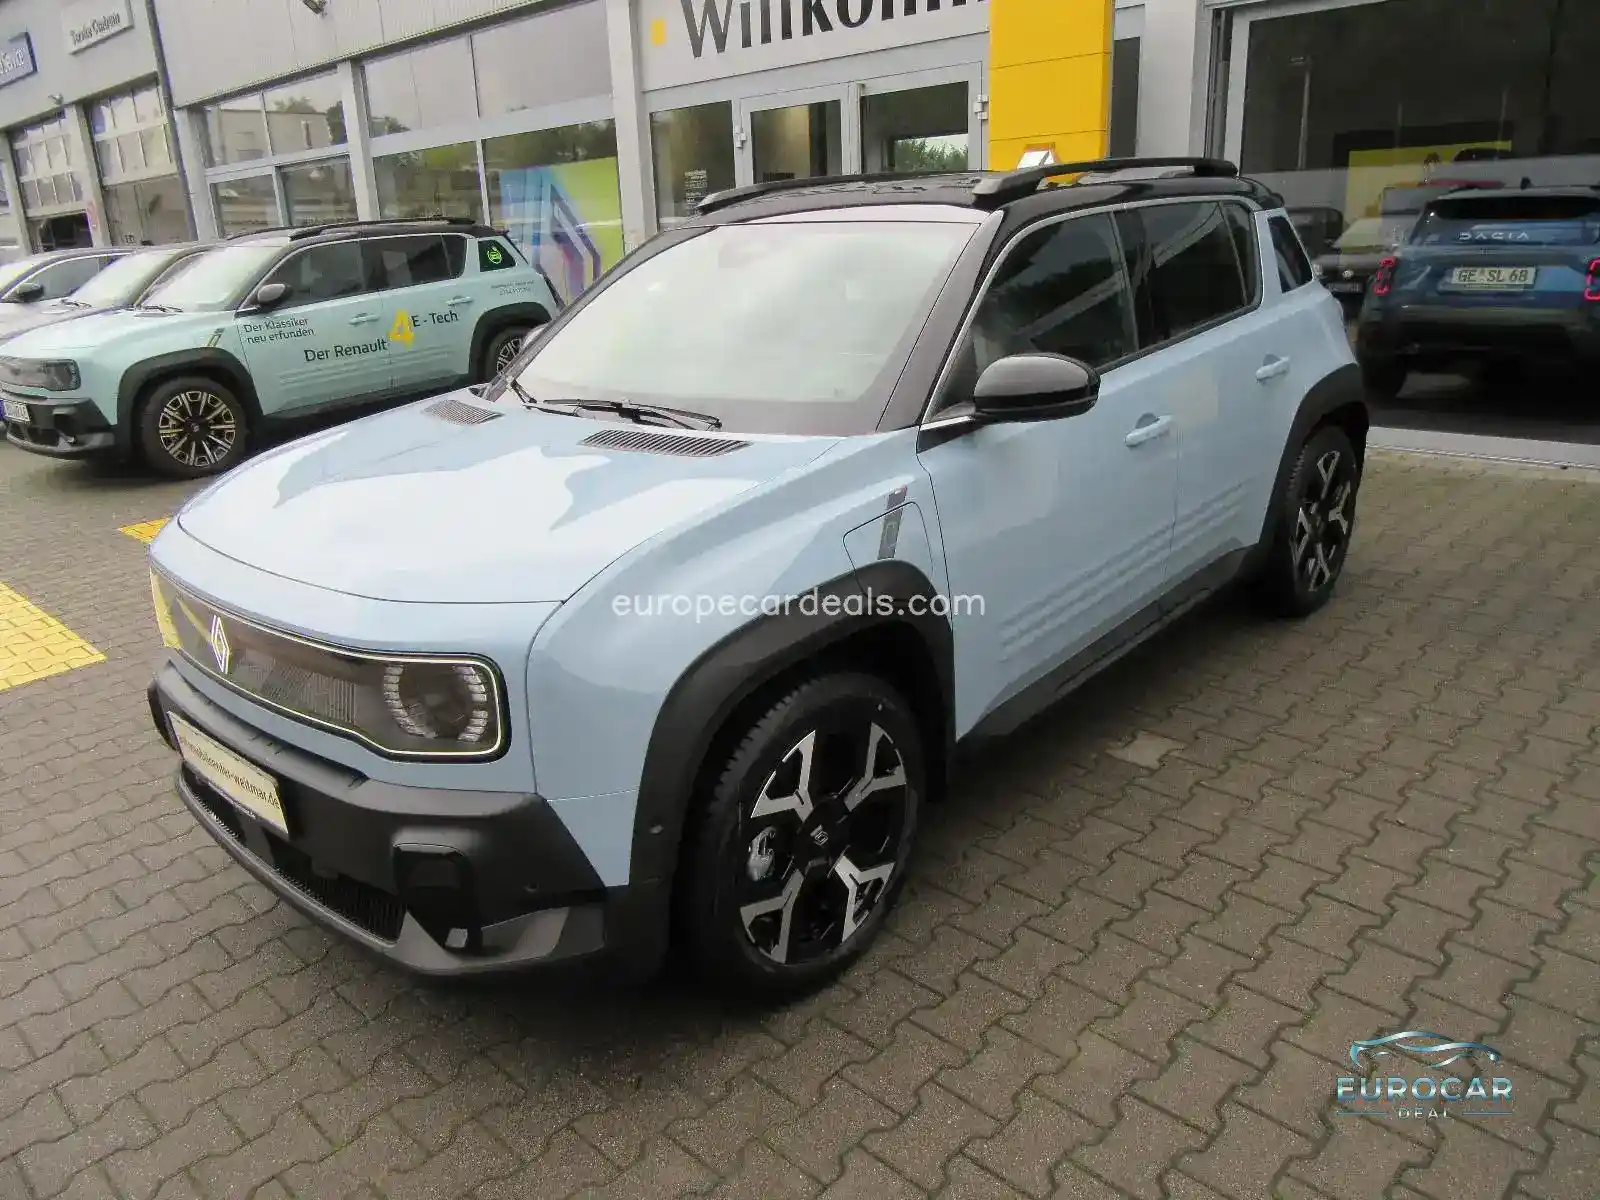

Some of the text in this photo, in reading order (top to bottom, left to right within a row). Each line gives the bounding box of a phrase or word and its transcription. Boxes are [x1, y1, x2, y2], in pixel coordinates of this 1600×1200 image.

[1459, 231, 1529, 240] DACIA
[1458, 269, 1529, 282] GE SL 68
[243, 317, 309, 333] Der Klassiker
[247, 327, 315, 345] neu erfunden
[304, 348, 331, 362] Der
[333, 338, 389, 358] Renault
[387, 308, 416, 350] 4
[429, 310, 459, 325] Tech
